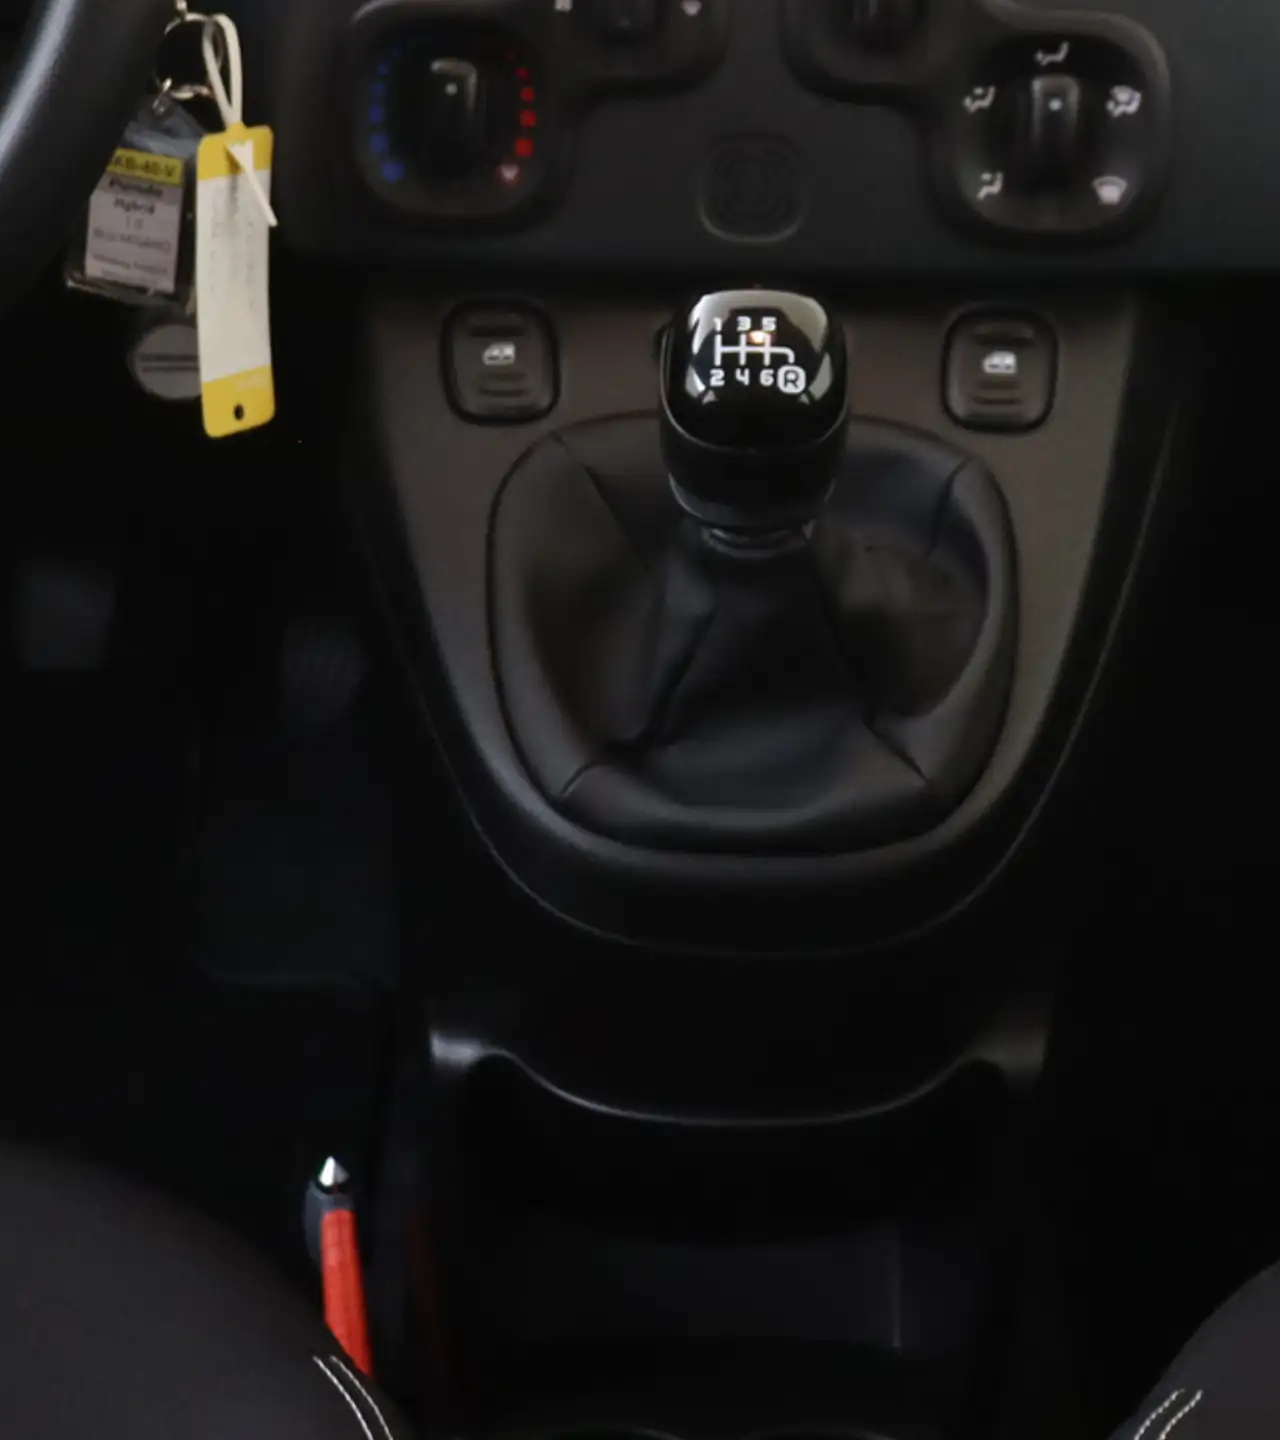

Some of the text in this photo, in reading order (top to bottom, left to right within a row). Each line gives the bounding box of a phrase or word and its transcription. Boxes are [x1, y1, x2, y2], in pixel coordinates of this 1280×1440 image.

[713, 315, 777, 332] 1 3 5
[709, 368, 799, 389] 2 4 6 R
